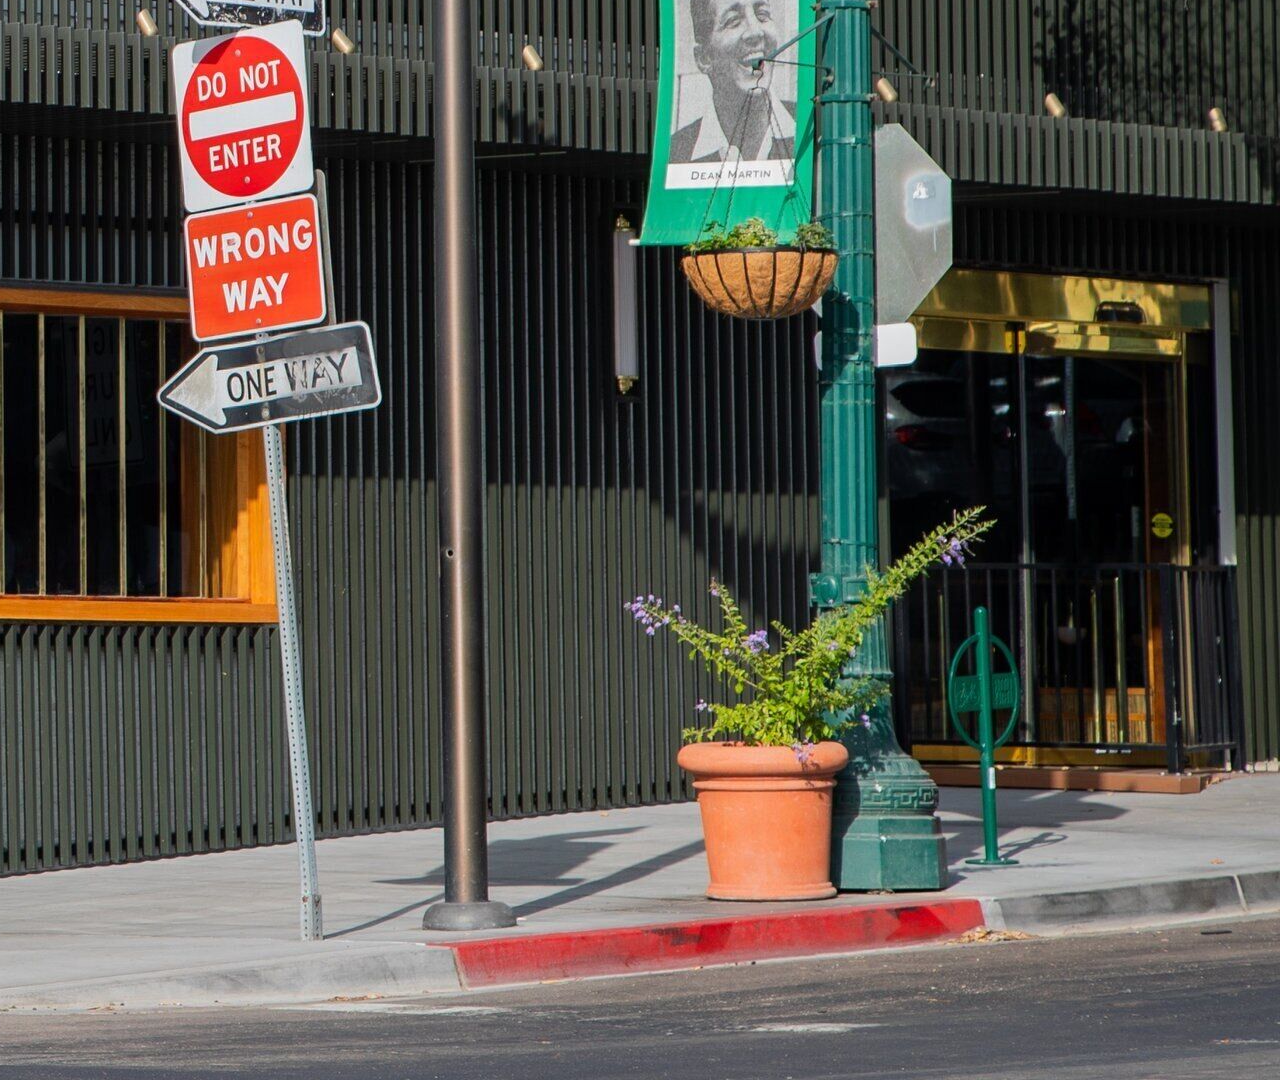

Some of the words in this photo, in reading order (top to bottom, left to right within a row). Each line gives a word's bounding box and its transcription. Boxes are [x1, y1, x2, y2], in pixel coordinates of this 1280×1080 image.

[197, 71, 227, 102] DO
[239, 59, 281, 93] NOT
[208, 133, 282, 173] ENTER
[193, 218, 314, 269] WRONG
[222, 272, 289, 314] WAY
[226, 366, 277, 403] ONE
[284, 352, 348, 393] WAY
